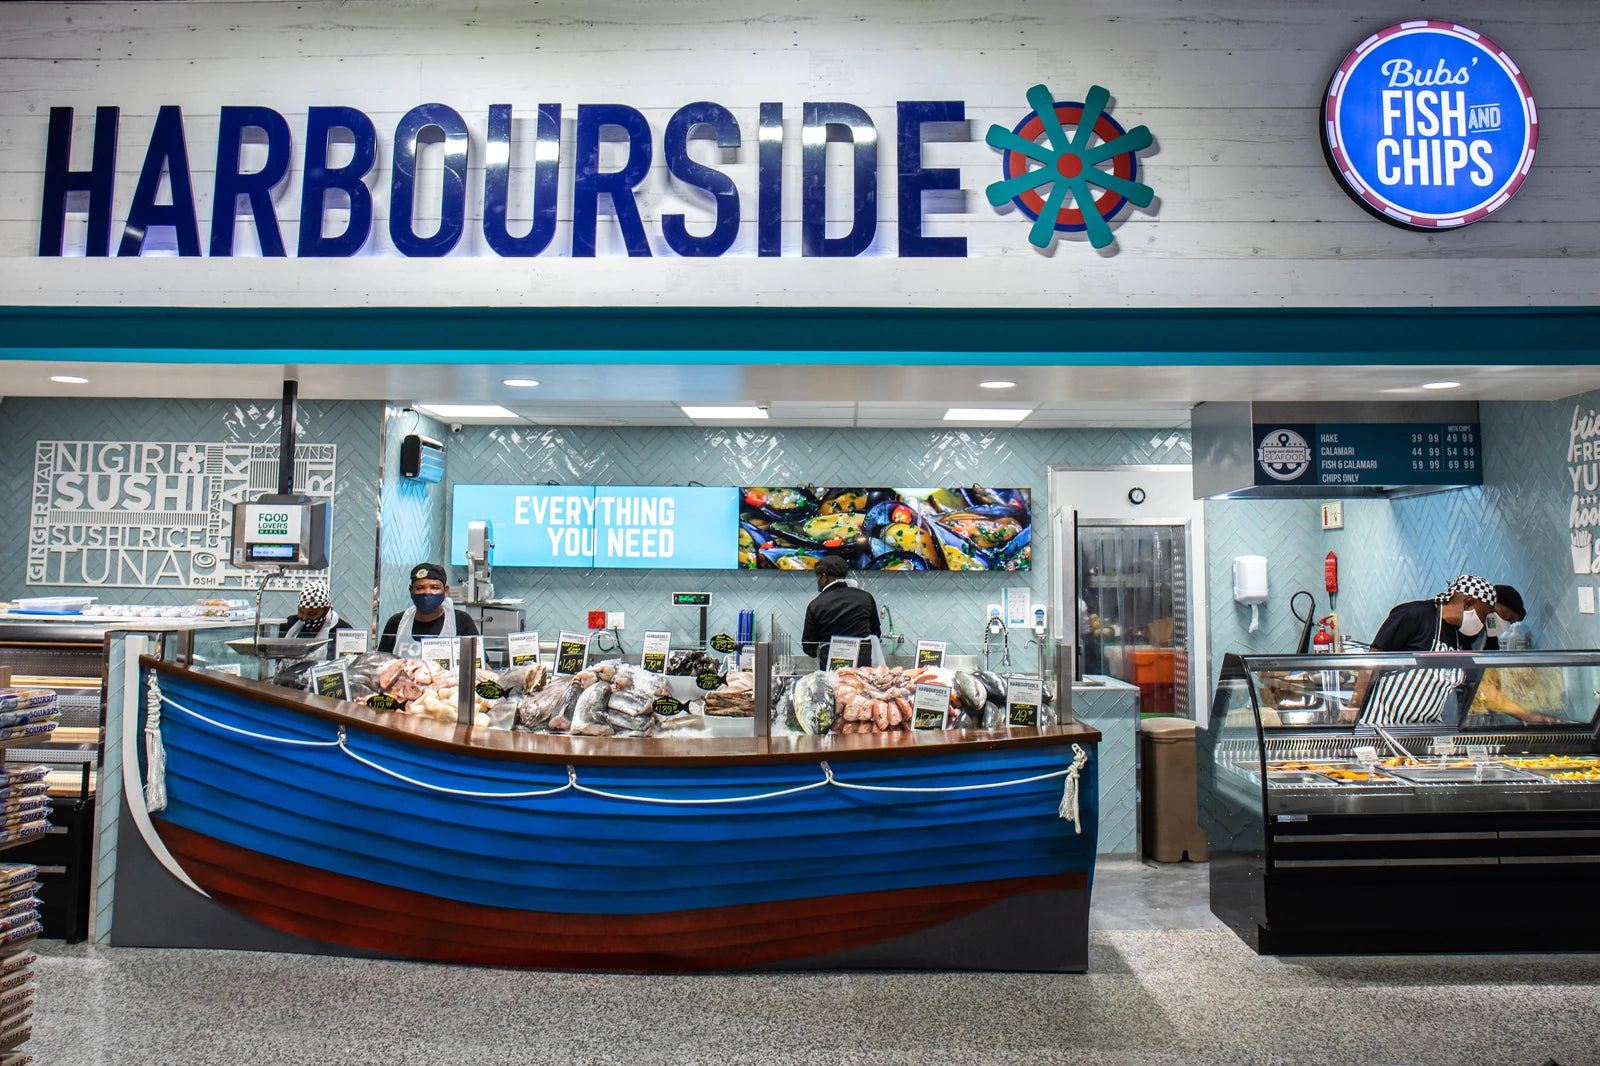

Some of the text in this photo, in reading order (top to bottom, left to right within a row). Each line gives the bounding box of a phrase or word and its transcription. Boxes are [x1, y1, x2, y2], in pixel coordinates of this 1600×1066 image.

[1380, 56, 1479, 88] Bubs'
[1382, 89, 1501, 137] FISH AND
[1376, 138, 1494, 187] CHIPS
[38, 101, 968, 258] HARBOURSIDE
[253, 445, 332, 460] PRWNS
[1320, 433, 1474, 443] HAKE 39 99 49 99
[1321, 447, 1475, 456] CALAMARI 44 99 54 99
[56, 442, 176, 474] NIGIRI
[1265, 453, 1305, 461] SEAFOOD
[1321, 460, 1475, 469] FISH & CALAMARI 59 99 69 99
[54, 473, 203, 511] SUSHI
[1322, 473, 1360, 483] CHIPS ONLY
[29, 443, 53, 581] GINGER MAKI
[208, 475, 222, 549] CHIRASHI
[258, 513, 288, 522] FOOD
[515, 495, 675, 526] EVERYTHING
[1569, 494, 1600, 529] hoo
[51, 525, 203, 549] SUSHI RICE
[547, 528, 675, 558] YOU NEED
[50, 549, 186, 586] TUNA
